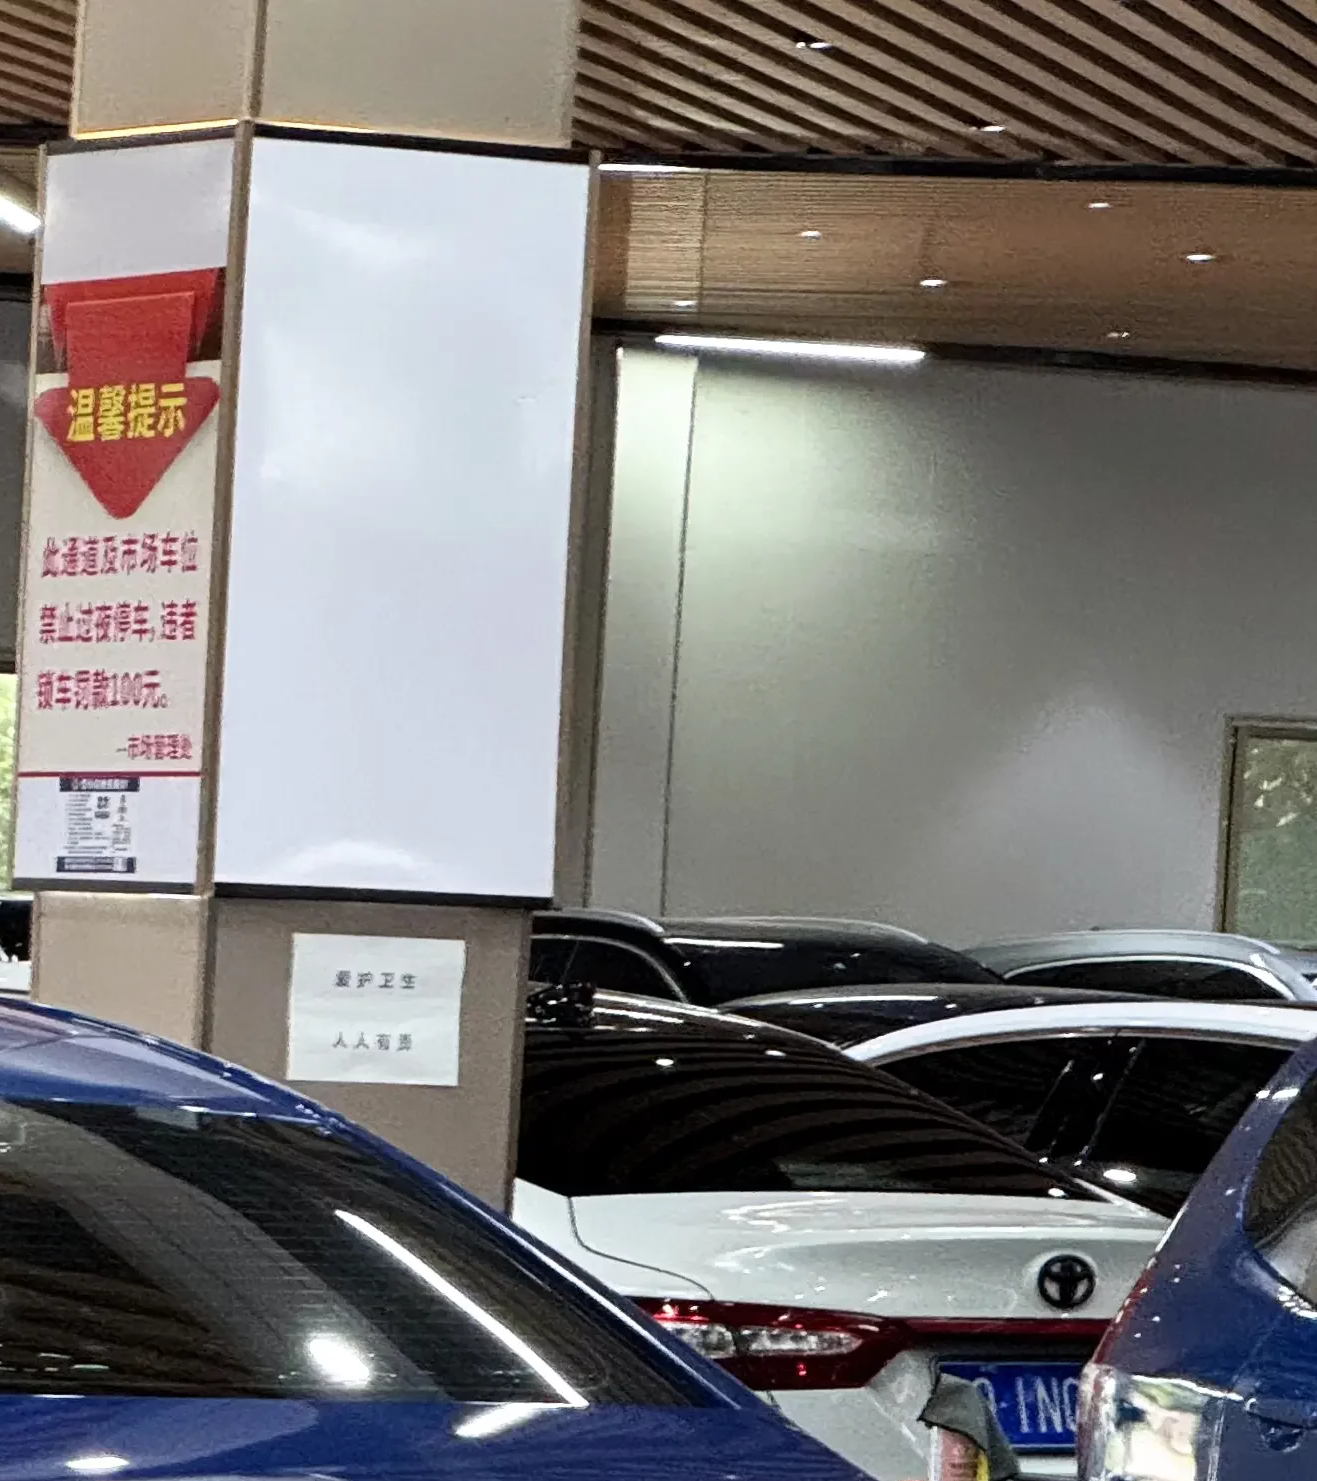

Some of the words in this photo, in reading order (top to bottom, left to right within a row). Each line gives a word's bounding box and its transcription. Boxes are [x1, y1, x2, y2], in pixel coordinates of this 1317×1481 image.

[67, 383, 187, 441] 温馨提示
[334, 970, 417, 990] 爱护卫生
[332, 1031, 413, 1051] 人人有责
